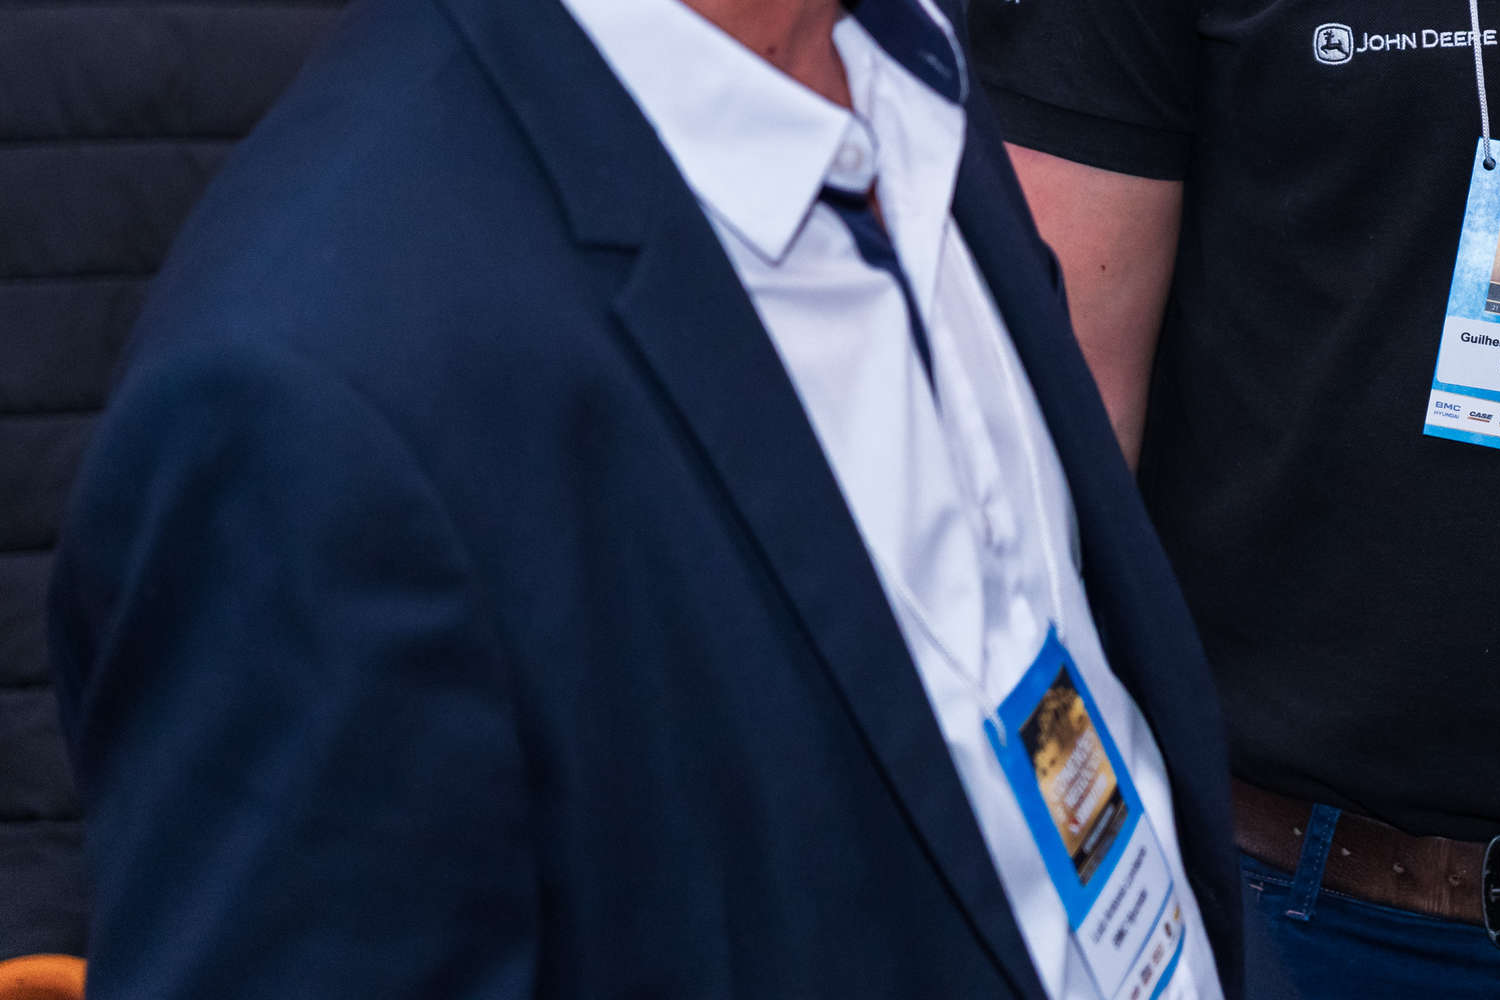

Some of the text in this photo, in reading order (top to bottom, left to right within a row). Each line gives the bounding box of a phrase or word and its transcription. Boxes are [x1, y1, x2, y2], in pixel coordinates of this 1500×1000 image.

[1357, 32, 1417, 52] JOHN
[1435, 401, 1461, 412] BMC
[1469, 411, 1494, 420] CASE
